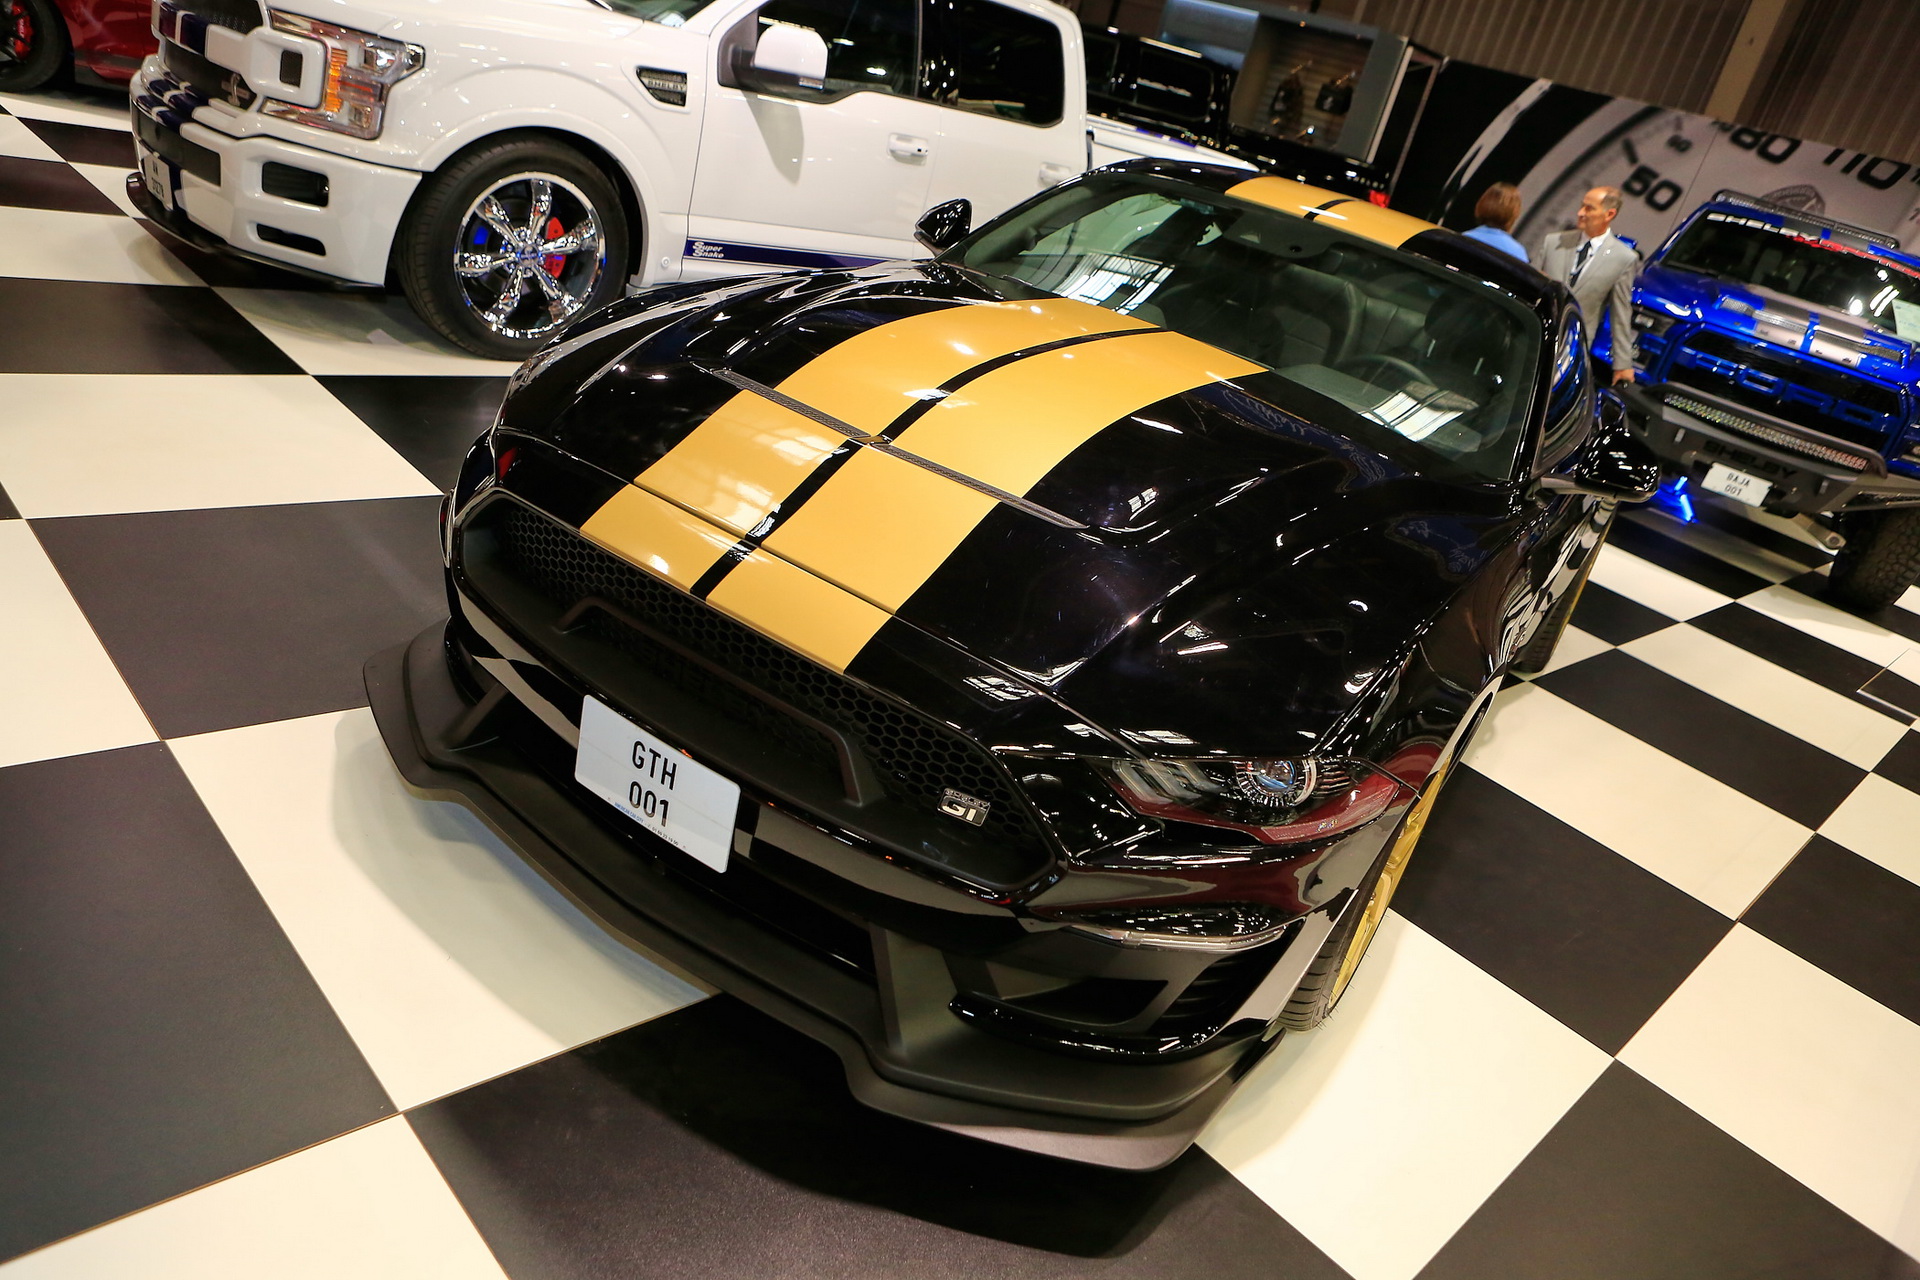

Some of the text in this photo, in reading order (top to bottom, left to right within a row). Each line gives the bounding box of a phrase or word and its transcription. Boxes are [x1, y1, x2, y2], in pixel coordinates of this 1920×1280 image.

[648, 80, 685, 91] SHELBY
[1707, 212, 1819, 242] SHELBY
[692, 241, 724, 252] Super
[692, 249, 725, 259] Snake
[1675, 345, 1894, 433] FORD
[1704, 438, 1797, 478] SHELBY
[1724, 484, 1742, 497] 001
[632, 740, 677, 791] GTH
[629, 781, 669, 828] 001
